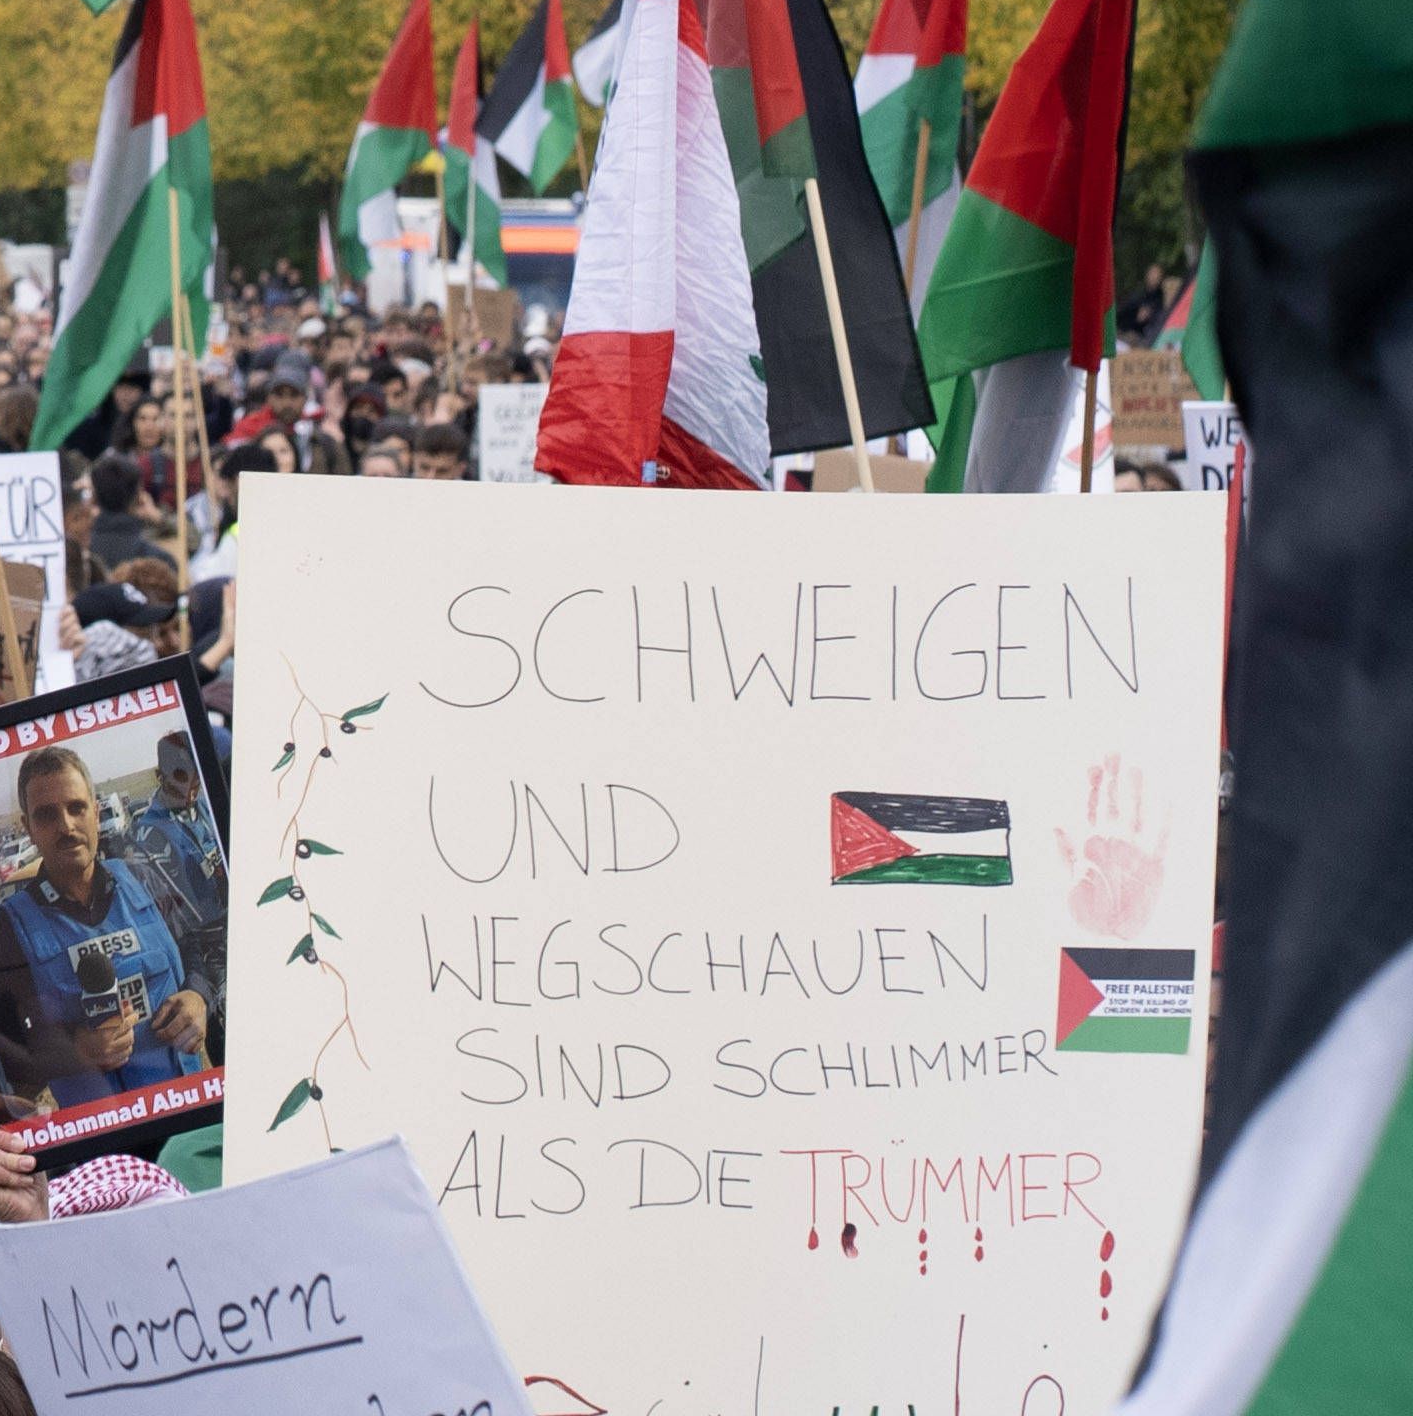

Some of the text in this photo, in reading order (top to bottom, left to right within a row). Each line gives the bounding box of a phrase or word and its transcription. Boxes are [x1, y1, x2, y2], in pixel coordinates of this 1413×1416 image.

[420, 578, 1139, 708] SCHWEIGEN
[17, 714, 64, 748] BY
[65, 683, 176, 733] ISRAEL
[429, 777, 680, 883] UND
[77, 933, 133, 959] PRESS
[422, 913, 987, 1006] WEGSCHAUEN
[1105, 984, 1194, 995] FREE PALESTINE!
[1109, 998, 1188, 1006] STOP THE KILLING OF
[455, 1028, 1059, 1107] SIND SCHLIMMER
[14, 1078, 225, 1149] Mohammad Abu H
[439, 1131, 1106, 1227] ALS DIE TRÜMMER
[41, 1258, 346, 1378] Mördern
